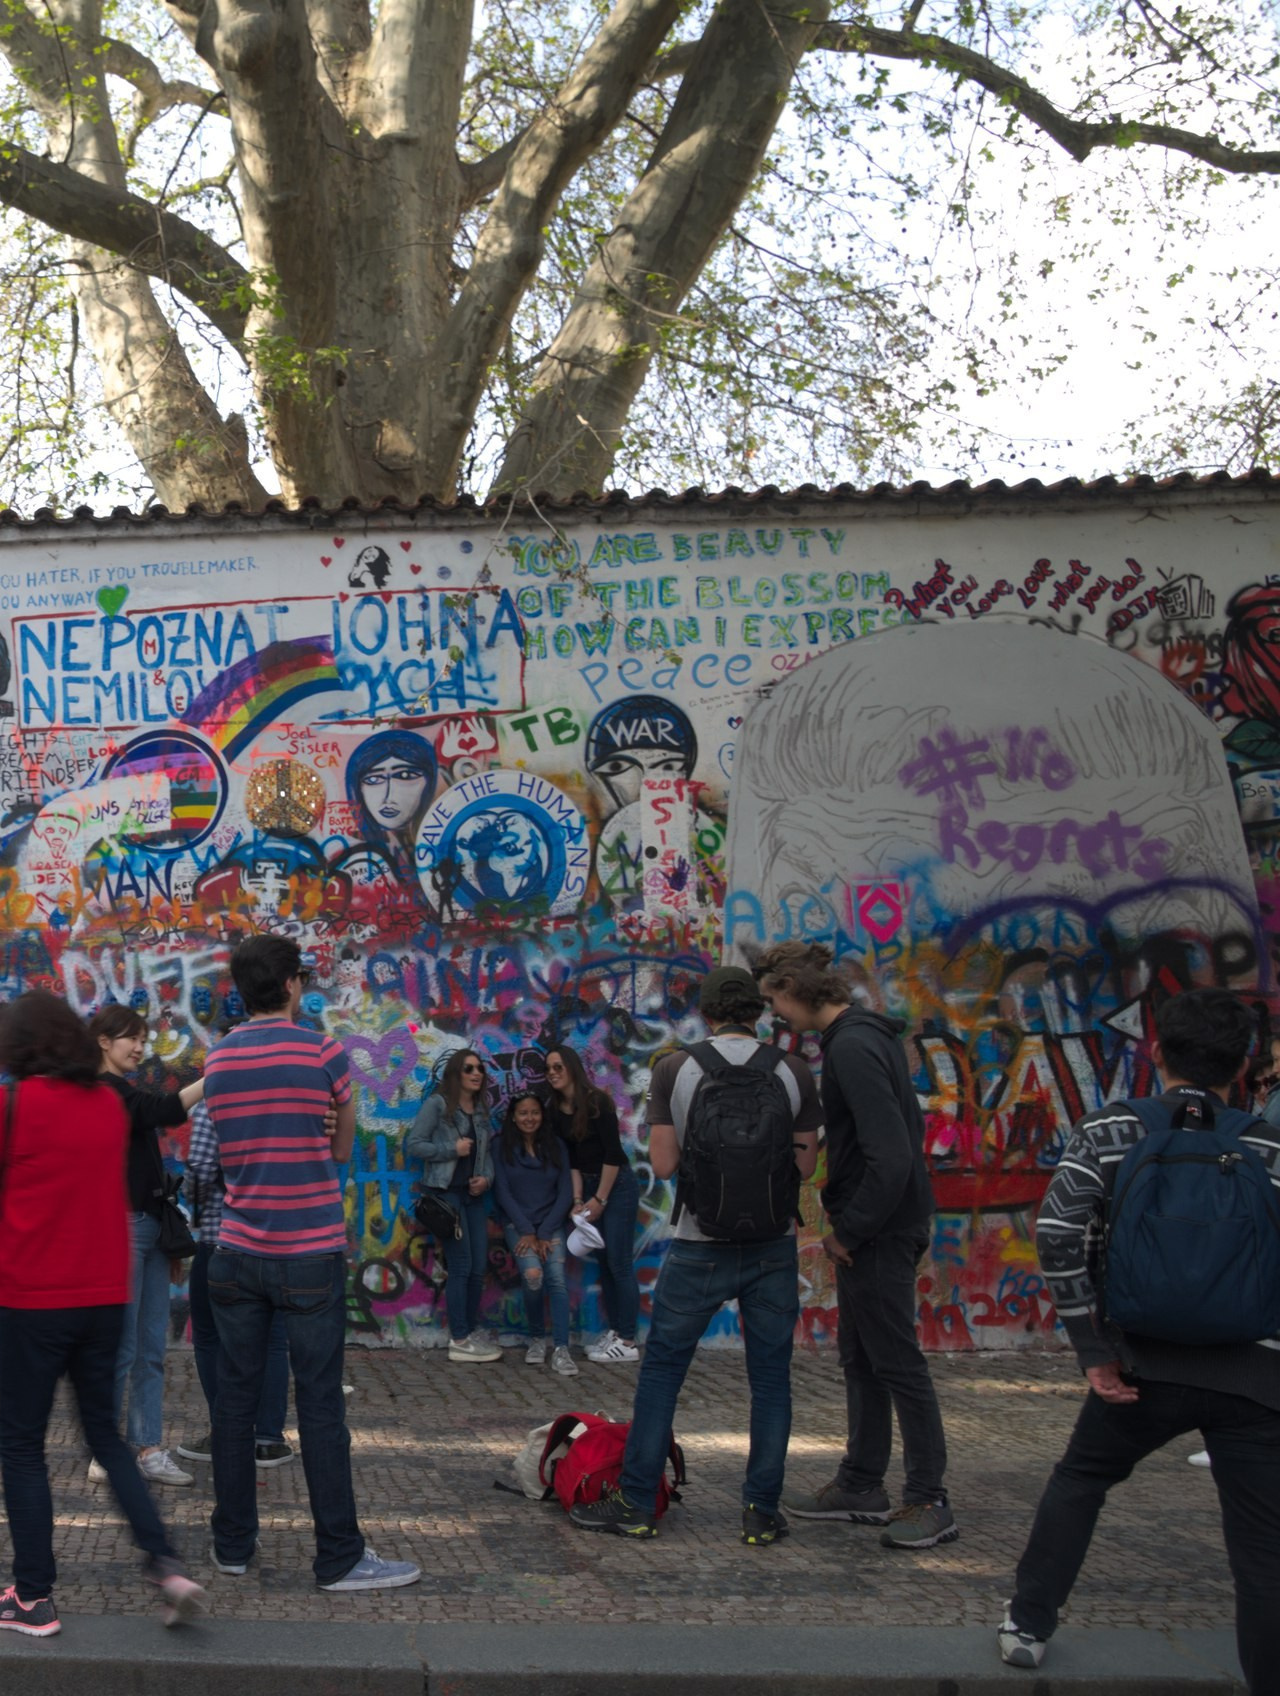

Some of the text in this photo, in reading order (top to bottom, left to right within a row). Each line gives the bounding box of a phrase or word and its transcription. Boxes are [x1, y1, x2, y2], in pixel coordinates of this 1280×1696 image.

[672, 527, 846, 562] BEAUTY
[88, 569, 102, 584] IF
[107, 564, 136, 581] YOU
[27, 590, 95, 608] ANYWAY
[517, 583, 574, 618] OF
[591, 573, 680, 611] THE
[695, 569, 891, 609] BLOSSOM
[523, 620, 615, 662] HOW
[624, 615, 702, 651] CAN
[605, 718, 680, 746] WAR
[454, 772, 500, 801] THE
[417, 804, 455, 863] SAVE
[516, 772, 590, 896] HUMANS
